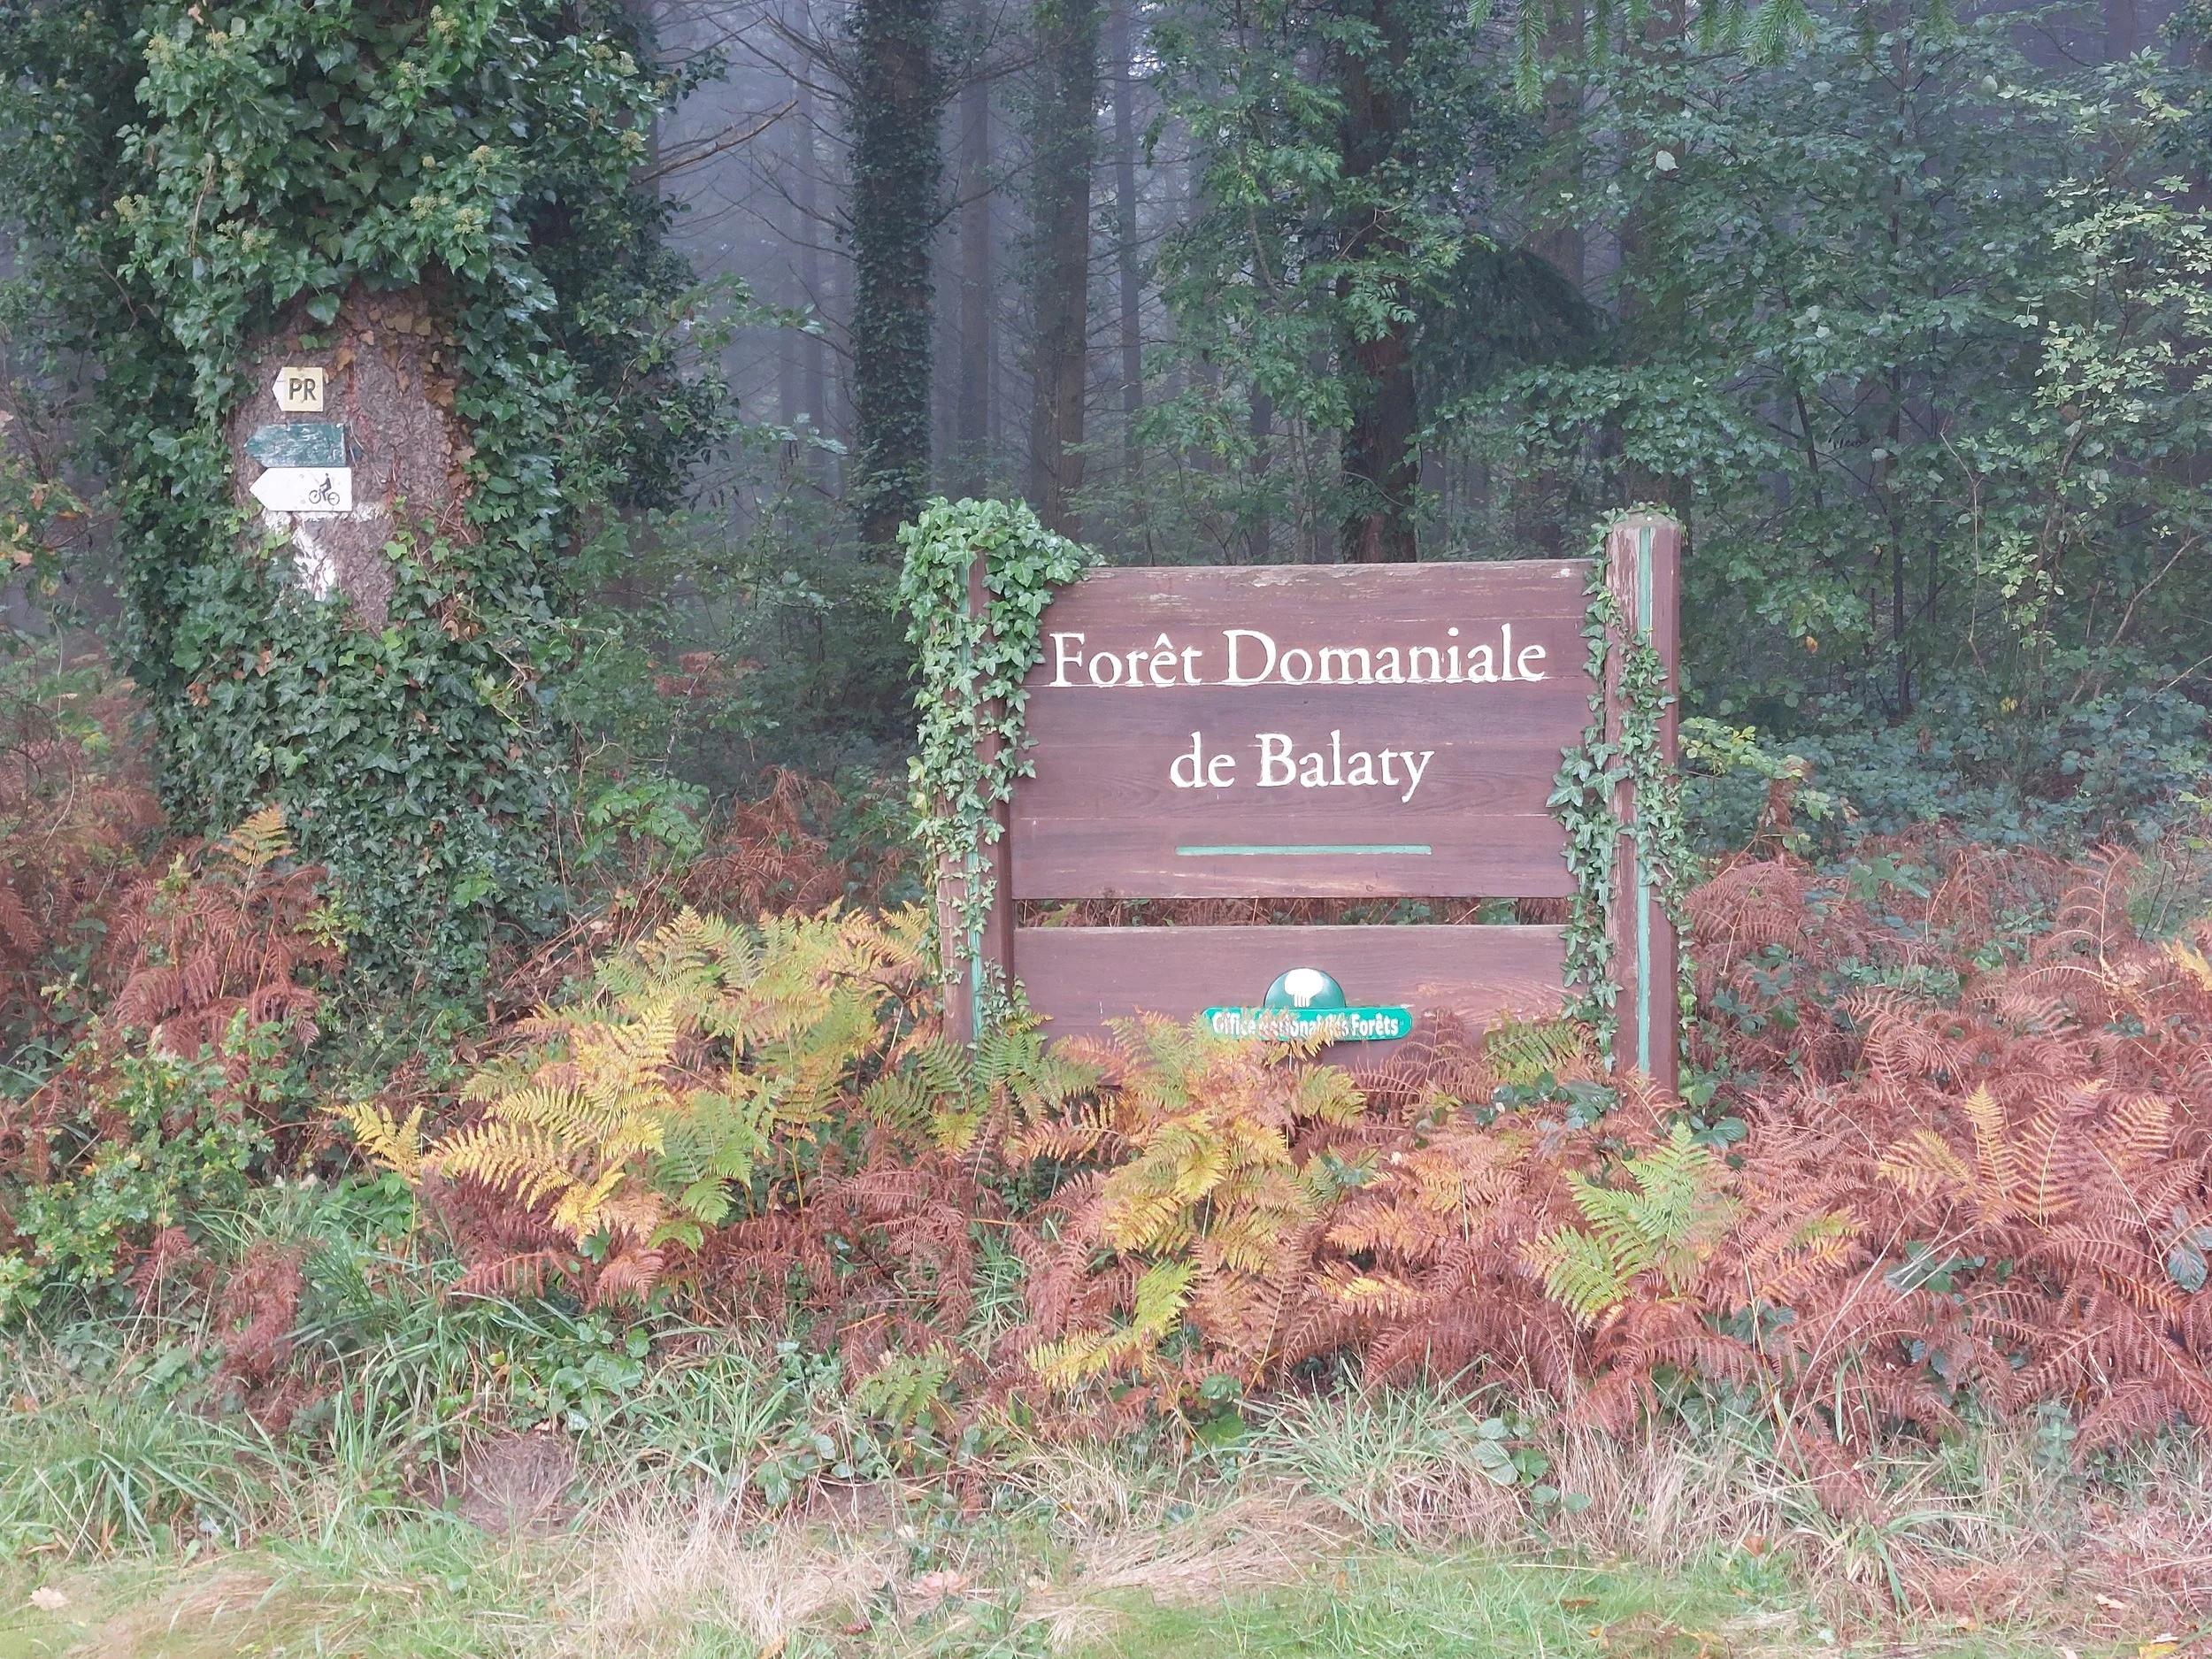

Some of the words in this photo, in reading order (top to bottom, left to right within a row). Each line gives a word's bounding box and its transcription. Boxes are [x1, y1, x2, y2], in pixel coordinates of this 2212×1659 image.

[289, 378, 316, 401] PR
[1048, 631, 1203, 687] Forêt
[1221, 623, 1547, 686] Domaniale
[1170, 731, 1236, 788] de
[1255, 730, 1434, 803] Balaty
[1350, 1012, 1399, 1036] Forêts
